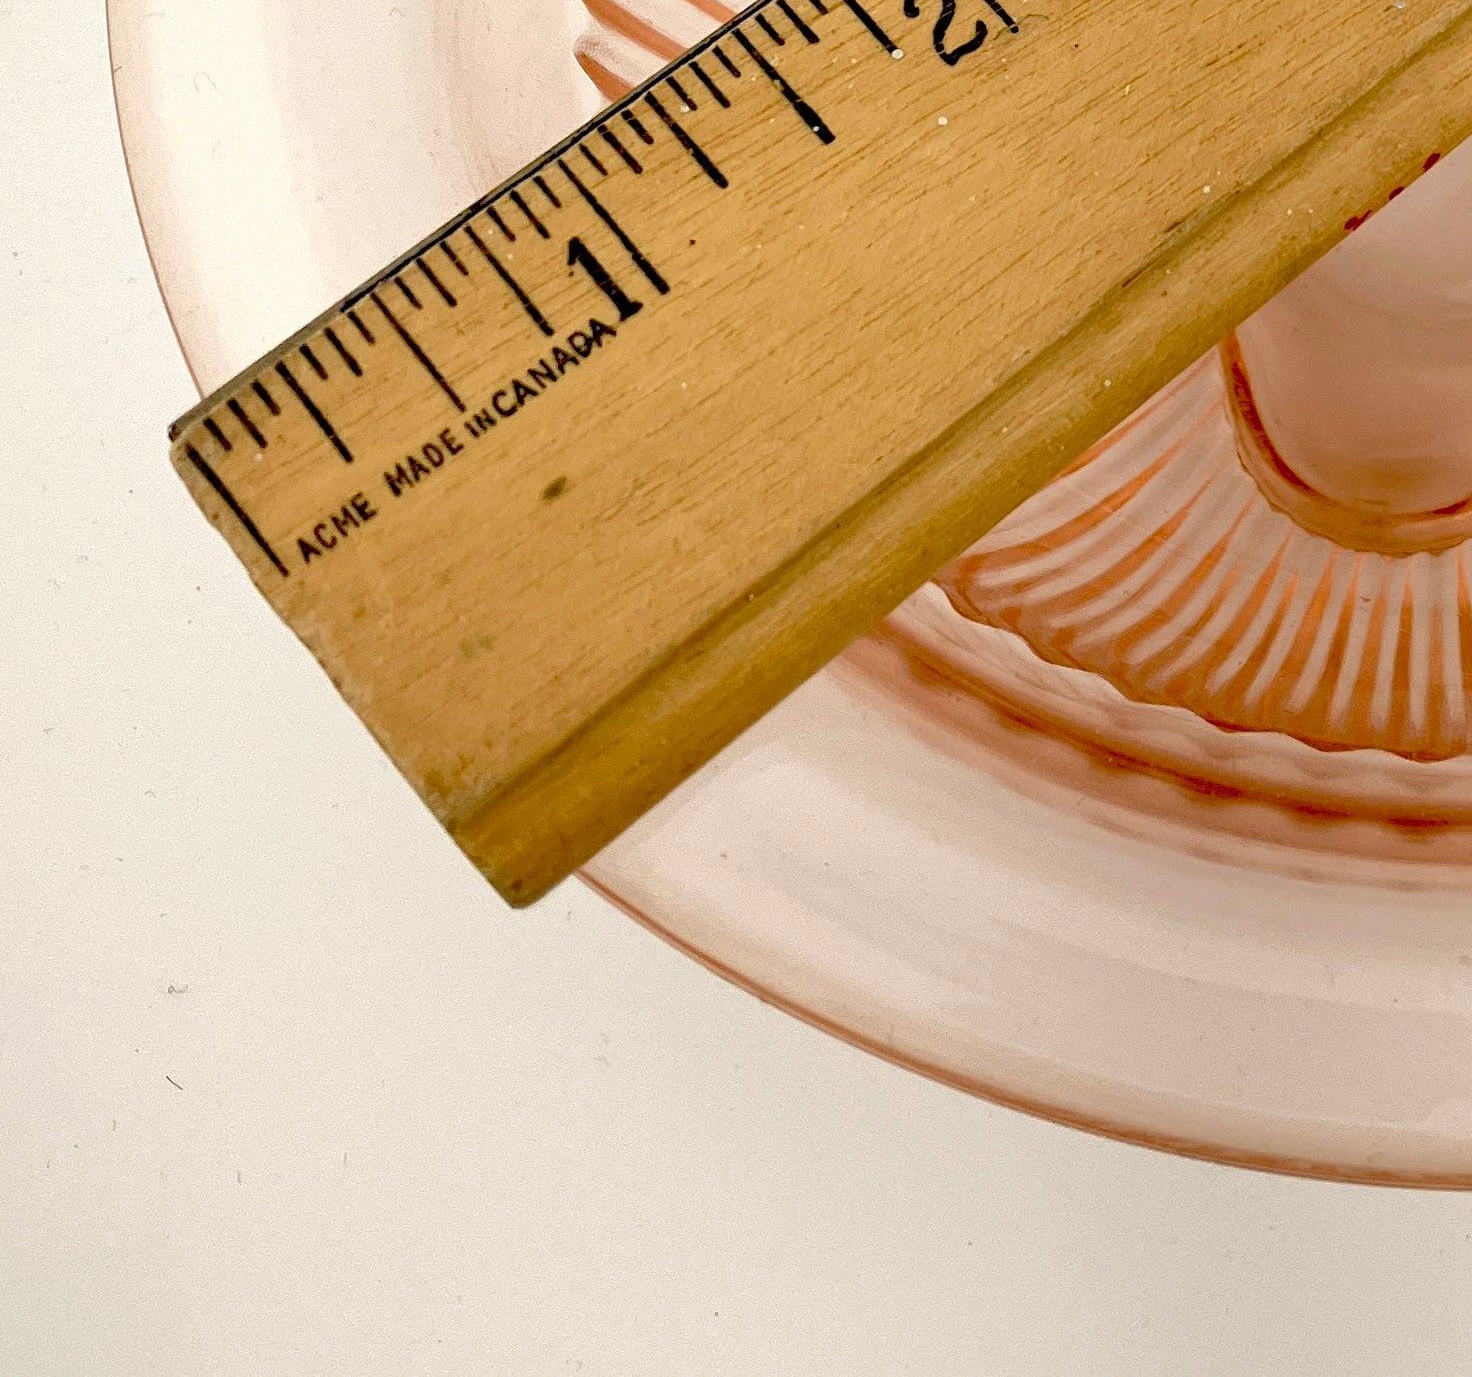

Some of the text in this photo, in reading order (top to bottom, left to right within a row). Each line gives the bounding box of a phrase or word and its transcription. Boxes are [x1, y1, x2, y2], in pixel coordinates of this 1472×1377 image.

[567, 236, 643, 322] 1
[297, 318, 617, 564] ACME MADE IN CANADA
